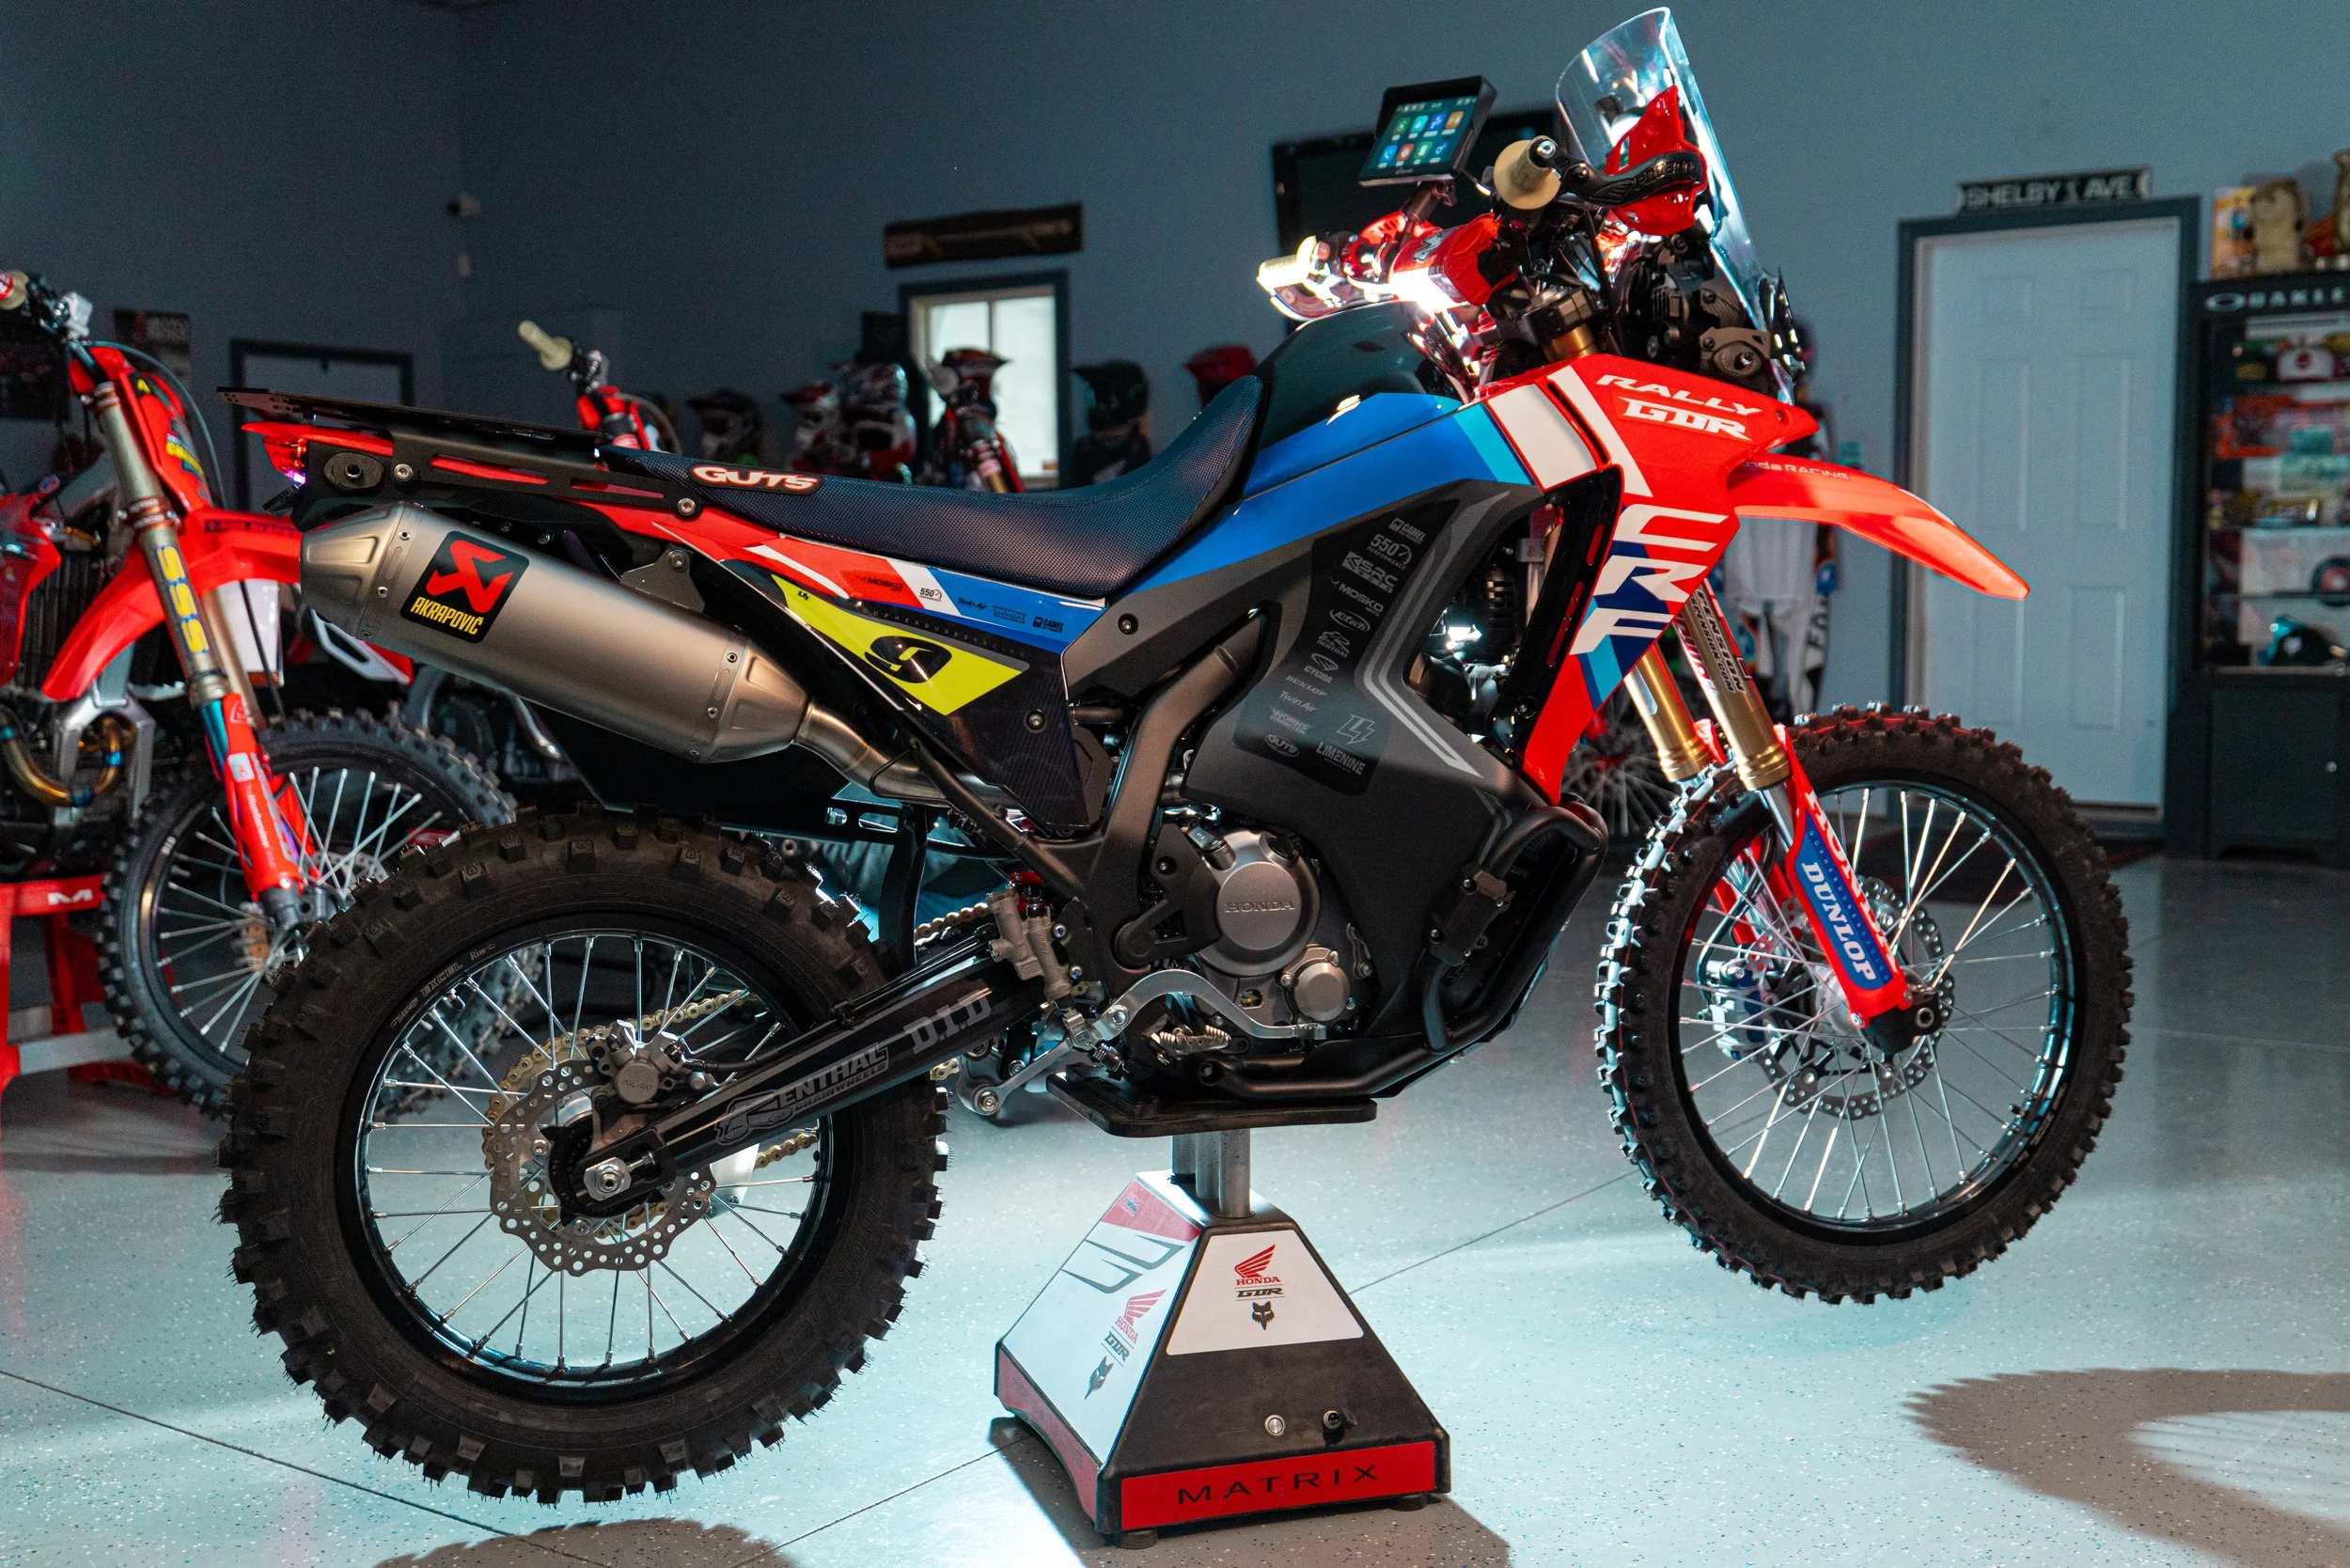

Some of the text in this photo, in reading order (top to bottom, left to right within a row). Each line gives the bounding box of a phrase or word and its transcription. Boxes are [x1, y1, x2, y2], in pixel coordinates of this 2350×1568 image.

[1596, 374, 1762, 416] RALLY
[1619, 396, 1752, 442] GDR
[691, 464, 819, 490] GUTS
[1785, 463, 1850, 480] RACING
[1370, 533, 1400, 557] 550
[1401, 523, 1426, 541] CAMEL
[1366, 545, 1406, 571] PERFORMANCE
[1358, 559, 1399, 588] SRC
[1569, 503, 1730, 655] CRF
[152, 545, 210, 655] SSS
[919, 588, 935, 598] 550
[957, 597, 988, 610] Twin Air
[1339, 583, 1385, 613] MOSKO
[410, 596, 485, 635] AKRAPOVIČ
[1316, 639, 1348, 658] RENTHAL
[1286, 675, 1327, 696] DUNLOP
[1304, 665, 1333, 683] CYCRA
[1279, 690, 1317, 713] Twin Air
[1267, 733, 1299, 753] GUTS
[1224, 901, 1295, 913] HONDA
[1801, 861, 1877, 981] DUNLOP
[420, 962, 464, 996] EXCEL
[794, 1063, 888, 1112] CHAINWHEELS
[1236, 1276, 1281, 1286] HONDA
[1237, 1288, 1284, 1298] GDR
[1115, 1315, 1139, 1344] HONDA
[1104, 1330, 1131, 1362] GDR
[1177, 1464, 1378, 1505] MATRIX
